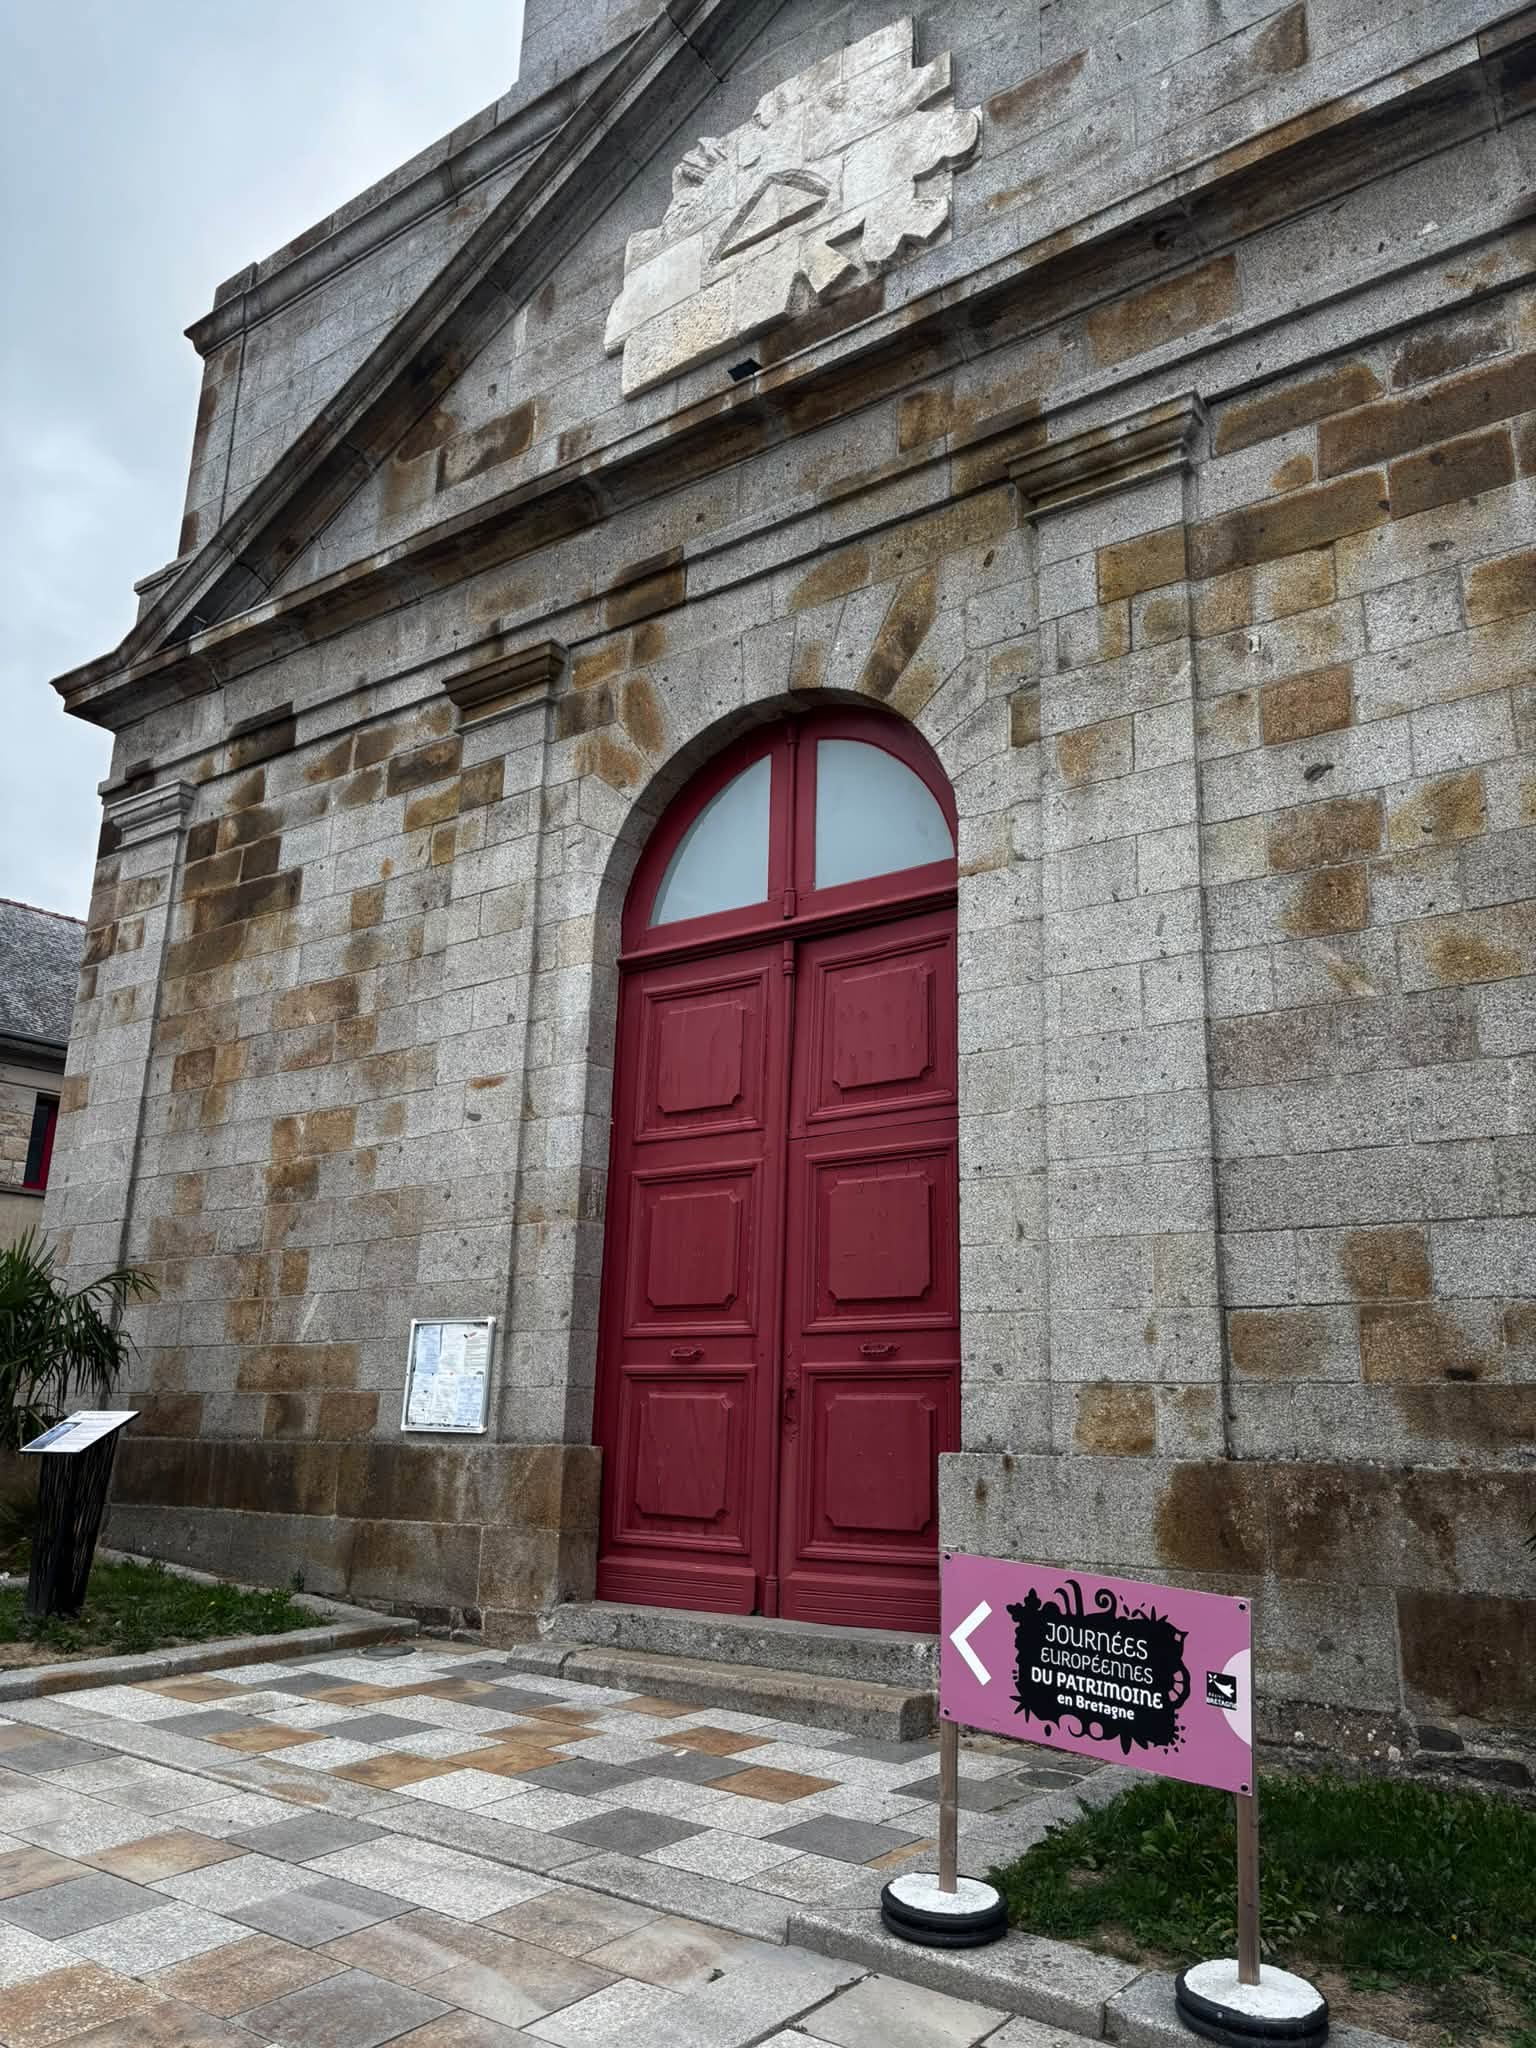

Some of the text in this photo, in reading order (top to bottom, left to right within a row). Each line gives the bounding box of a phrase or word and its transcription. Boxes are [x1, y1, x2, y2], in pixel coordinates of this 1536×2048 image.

[1045, 1622, 1148, 1660] JOURNÉES
[1031, 1666, 1163, 1709] DU PATRIMOINE
[1057, 1694, 1135, 1720] en Bretagne
